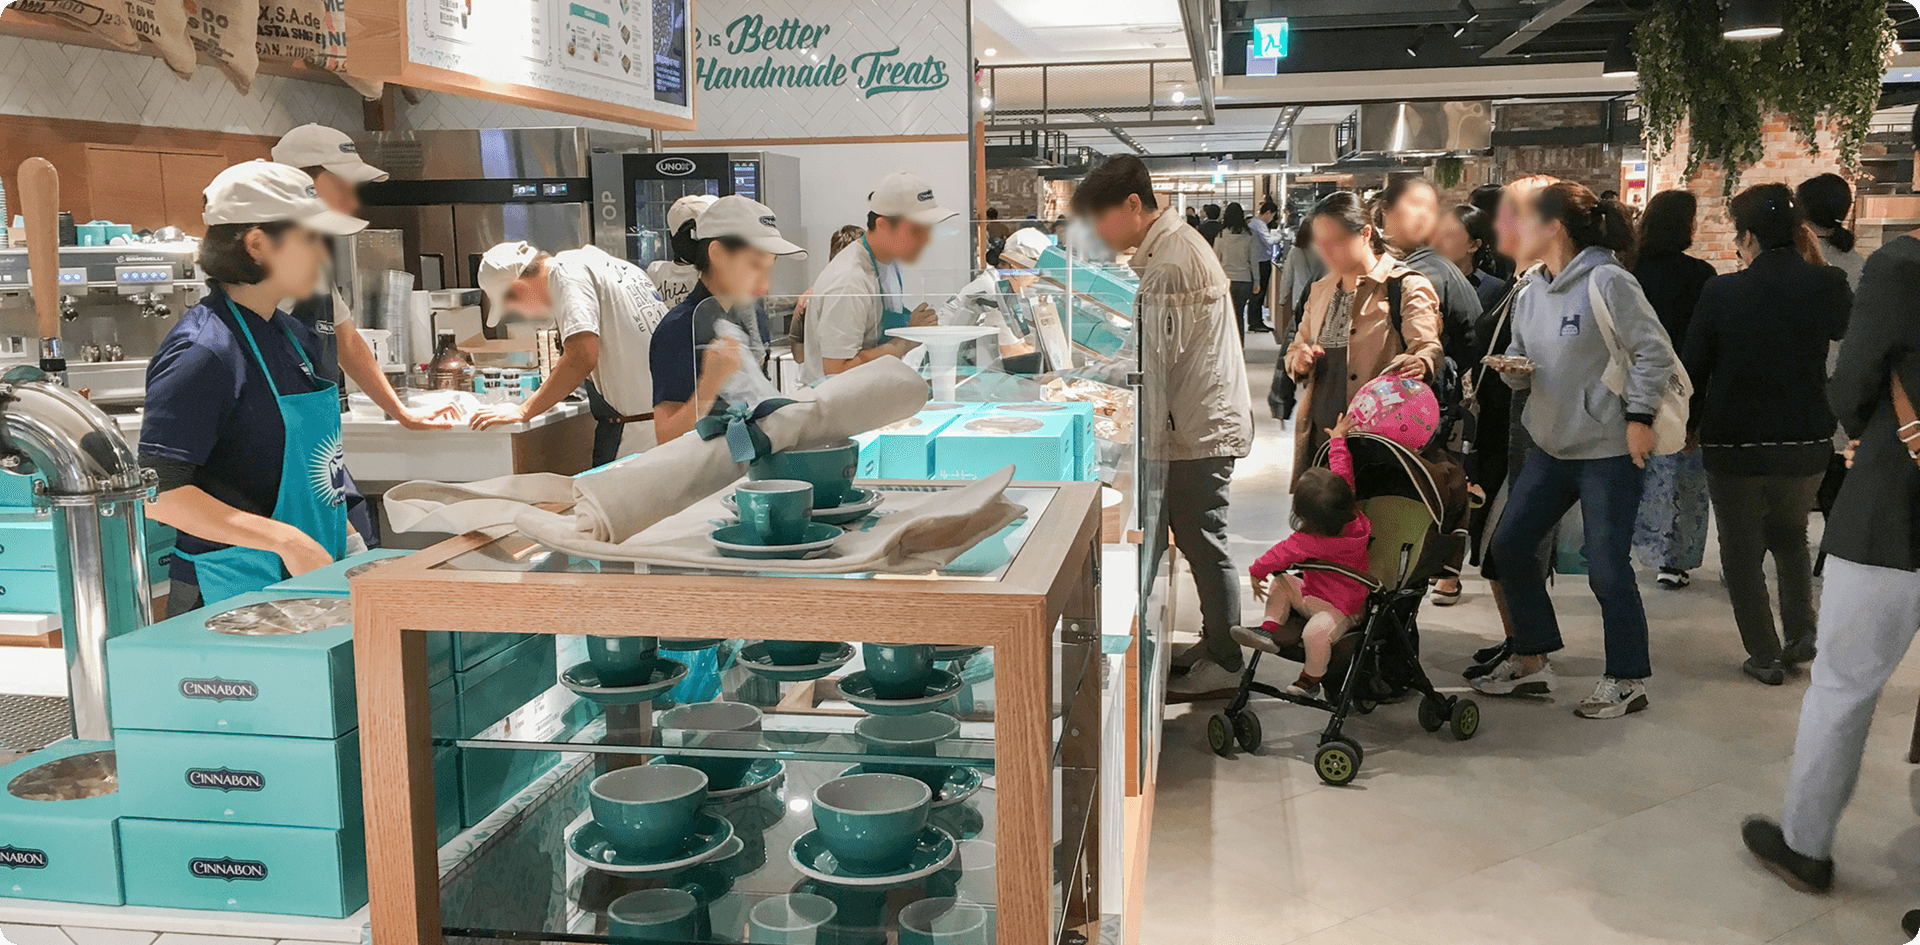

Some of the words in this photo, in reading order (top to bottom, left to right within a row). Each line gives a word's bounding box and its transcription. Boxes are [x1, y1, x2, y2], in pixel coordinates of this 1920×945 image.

[726, 13, 830, 55] Better
[696, 54, 847, 91] Handmade
[851, 46, 949, 99] Treats
[660, 162, 690, 171] UNOX
[183, 681, 254, 697] CINNABON
[190, 771, 260, 787] CINNABON
[193, 861, 263, 877] CINNABON
